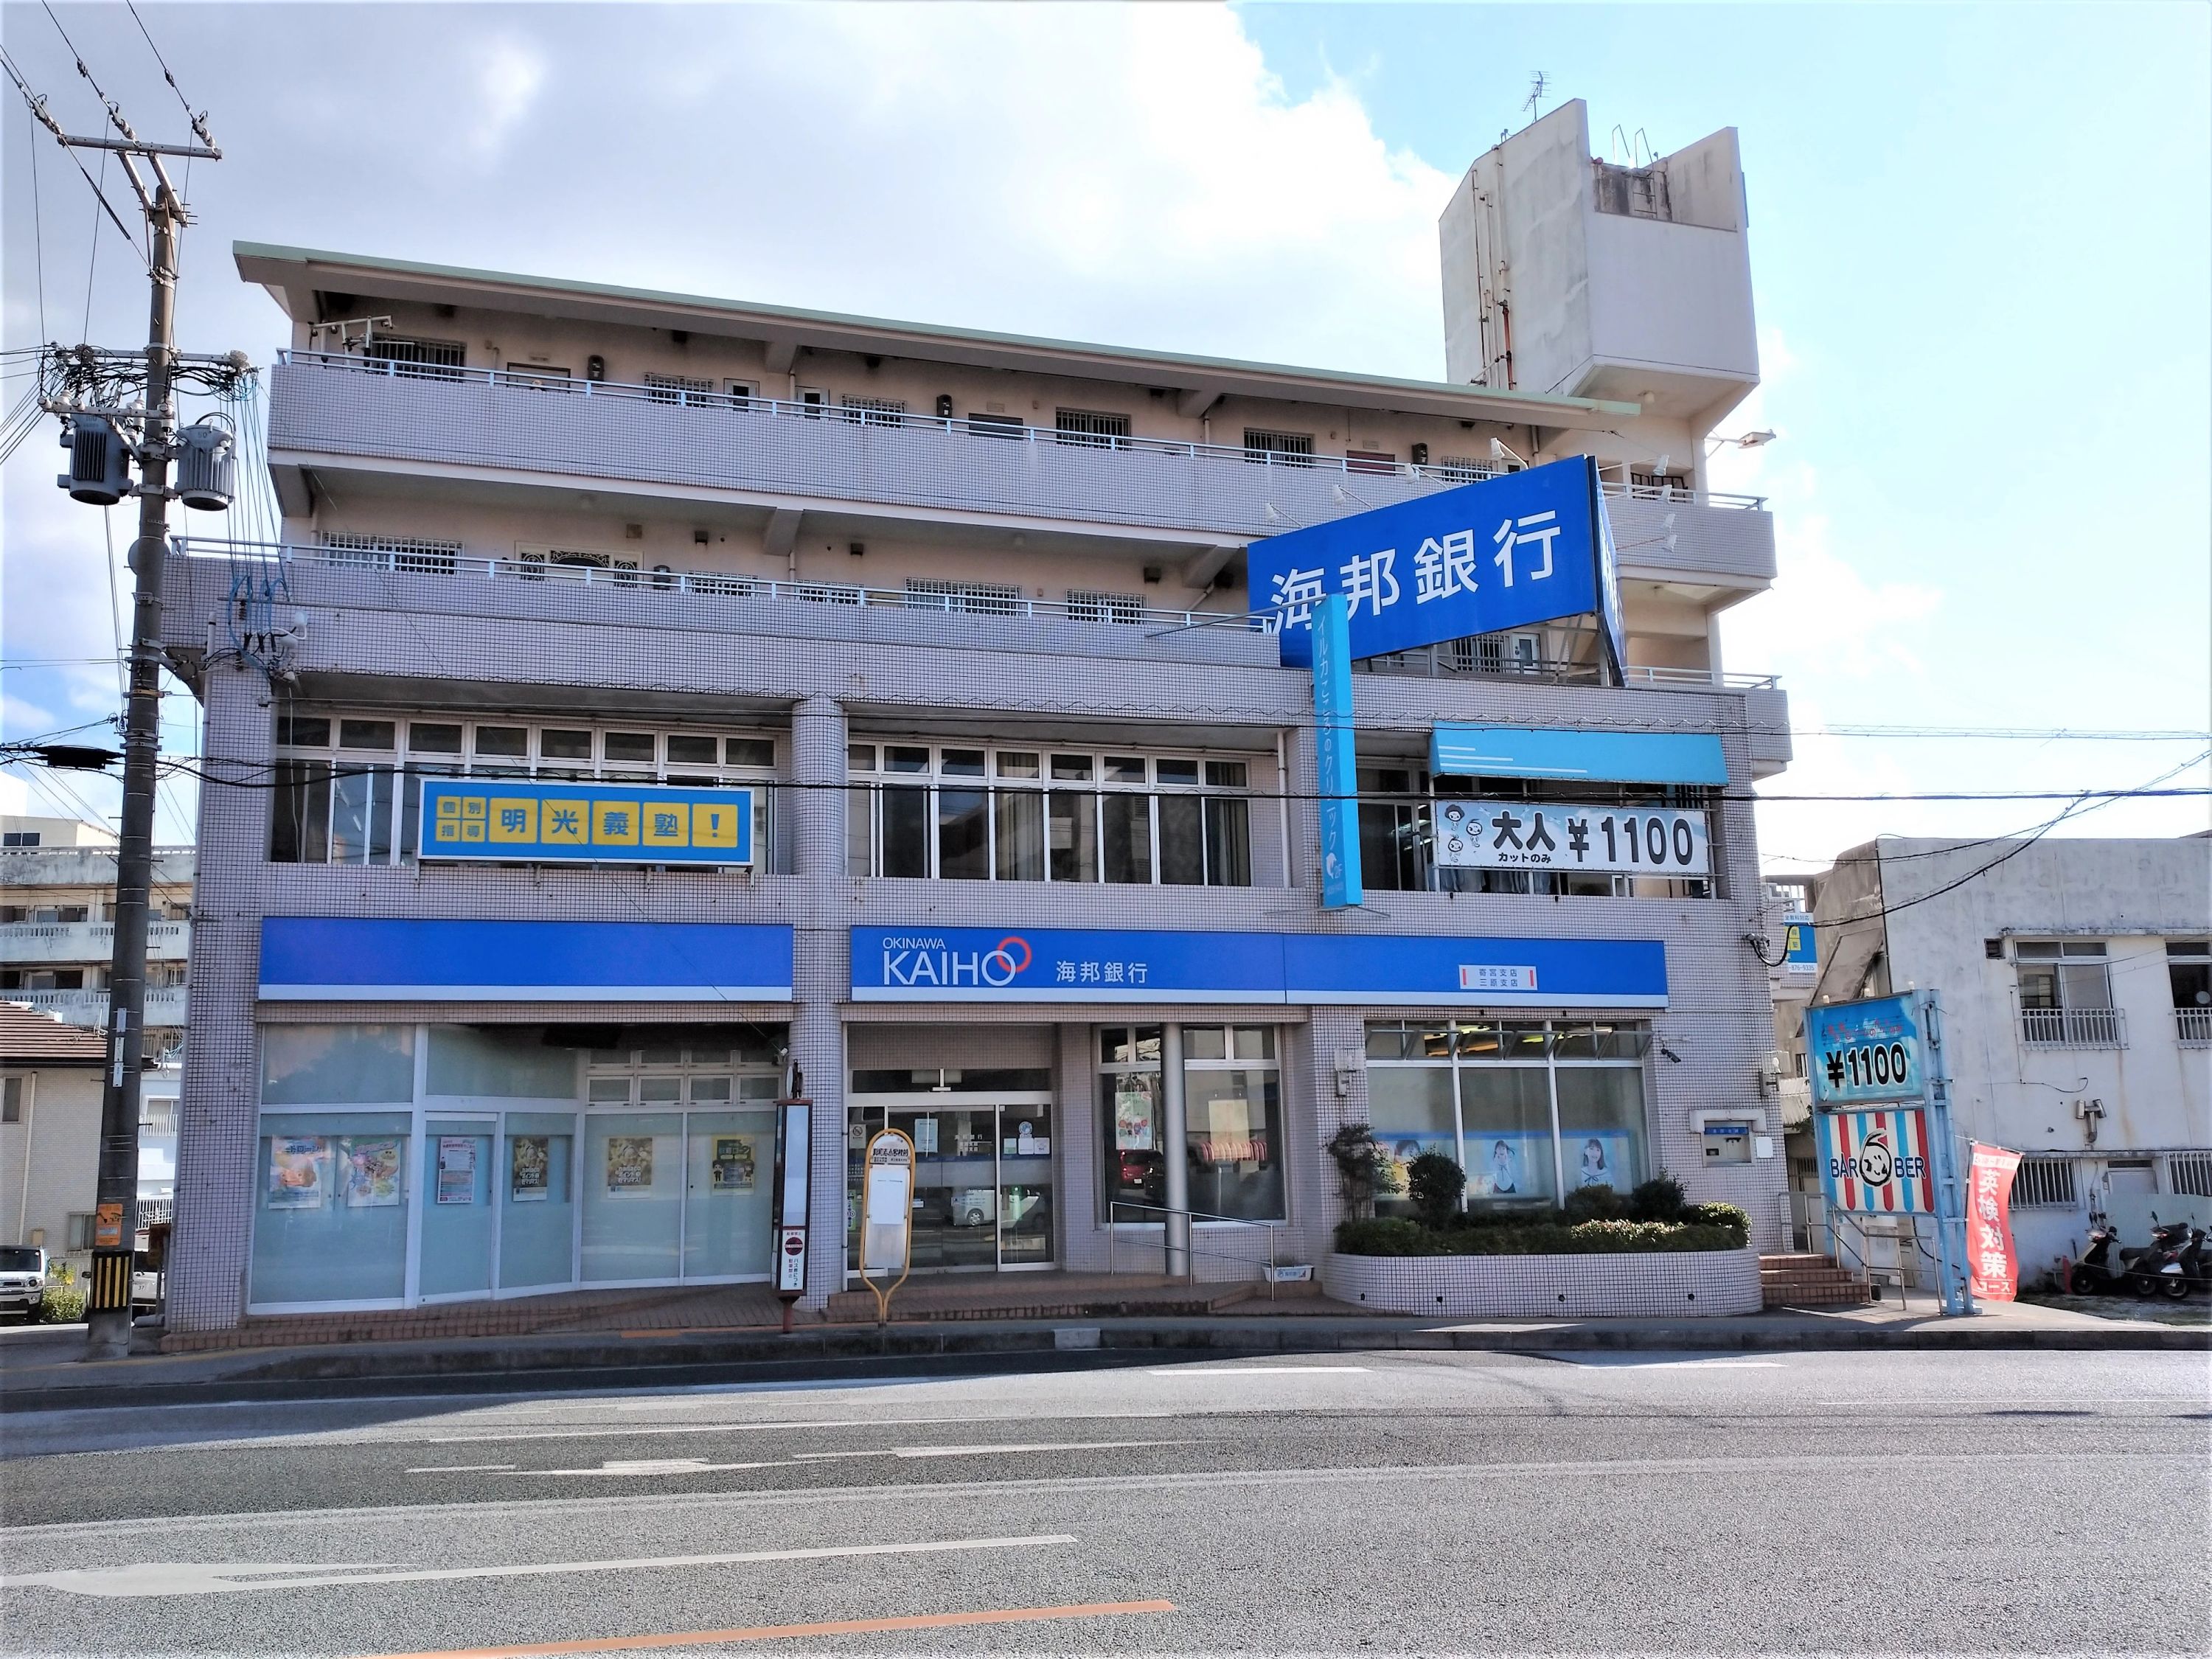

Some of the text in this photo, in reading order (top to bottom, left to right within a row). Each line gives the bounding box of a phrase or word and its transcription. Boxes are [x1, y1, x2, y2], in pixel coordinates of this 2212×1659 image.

[1270, 509, 1562, 634] 海邦銀行
[1492, 811, 1556, 852] 大人
[1568, 816, 1693, 865] ¥1100
[1498, 852, 1551, 864] カットのみ
[883, 937, 946, 950] OKINAWA
[884, 950, 1016, 987] KAIHO
[1056, 960, 1148, 984] 海邦銀行
[1479, 968, 1517, 977] 寄宮支店
[1480, 978, 1518, 987] 三原支店
[1826, 1043, 1907, 1088] ¥1100
[1978, 1169, 2007, 1279] 英検対策
[1978, 1281, 2011, 1293] コース
